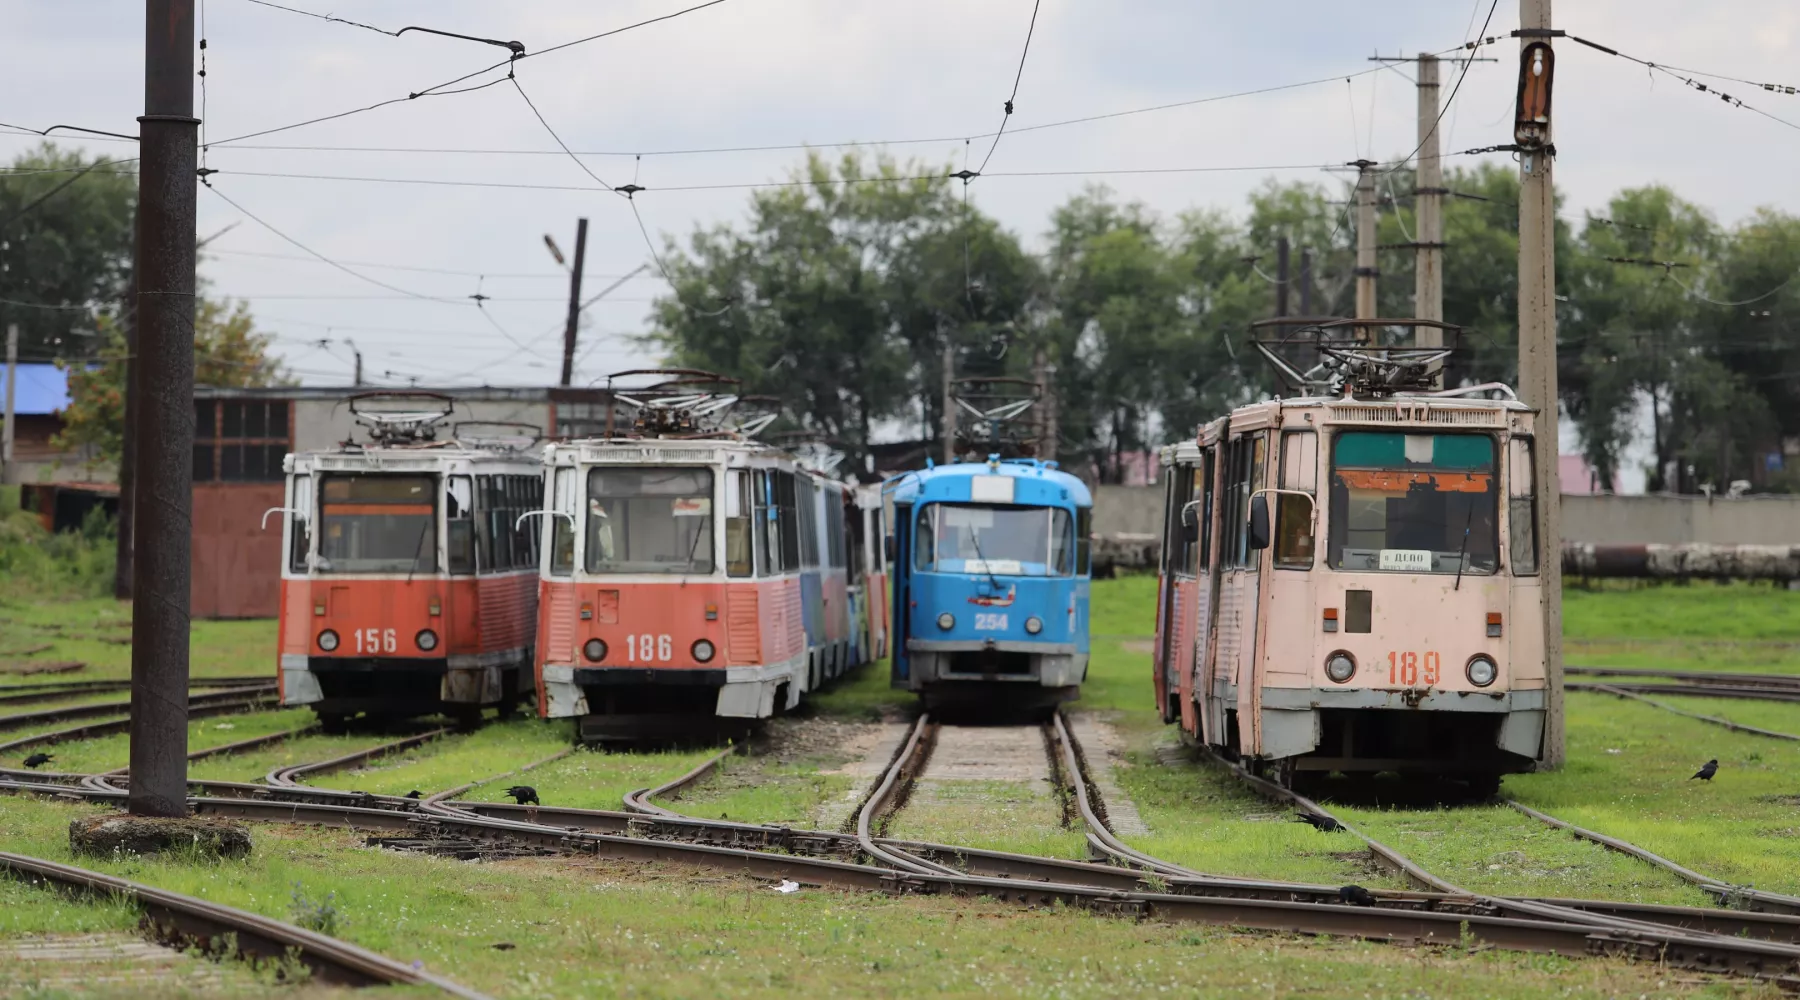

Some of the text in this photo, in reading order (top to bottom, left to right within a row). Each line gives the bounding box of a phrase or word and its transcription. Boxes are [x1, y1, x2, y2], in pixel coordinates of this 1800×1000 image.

[975, 613, 1008, 631] 254
[354, 628, 397, 653] 156
[626, 634, 672, 662] 186
[1388, 651, 1440, 685] 189
